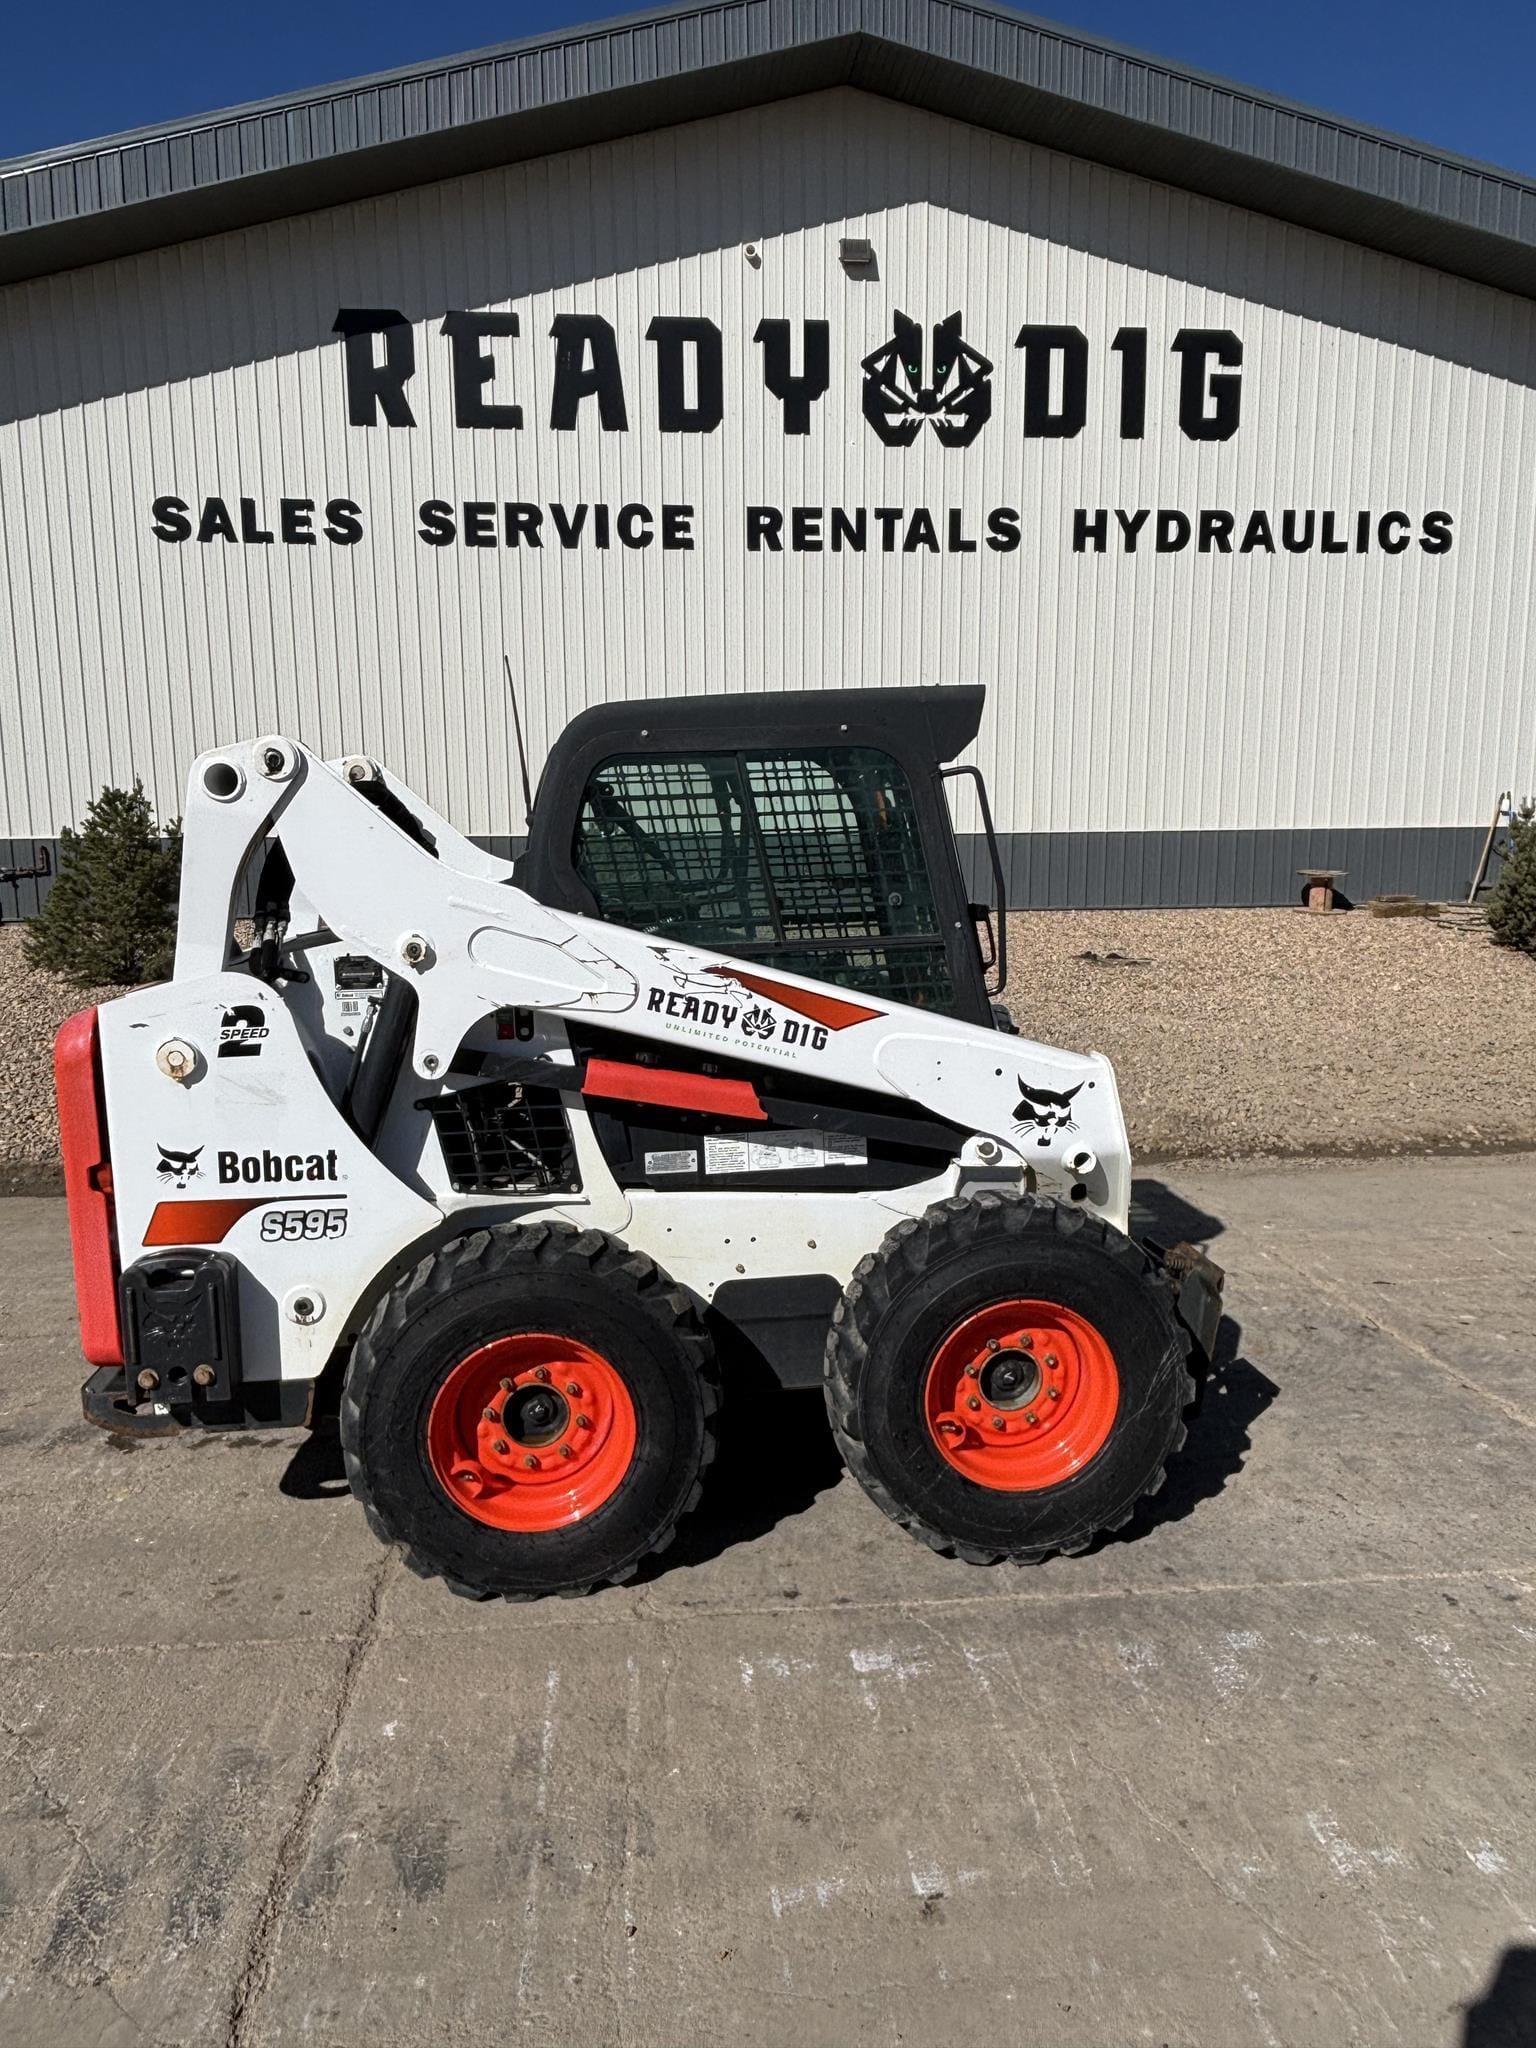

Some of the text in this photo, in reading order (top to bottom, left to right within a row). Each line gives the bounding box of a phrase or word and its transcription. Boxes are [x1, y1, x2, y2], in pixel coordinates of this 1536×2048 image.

[332, 308, 1243, 441] READY DIG
[151, 495, 1455, 555] SALES SERVICE RENTALS HYDRAULICS
[218, 1004, 266, 1058] 2
[220, 1027, 270, 1040] SPEED
[646, 986, 829, 1051] READY DIG
[665, 1022, 798, 1059] UNLIMITED POTENTIAL
[217, 1150, 338, 1184] Bobcat
[260, 1208, 348, 1243] S595
